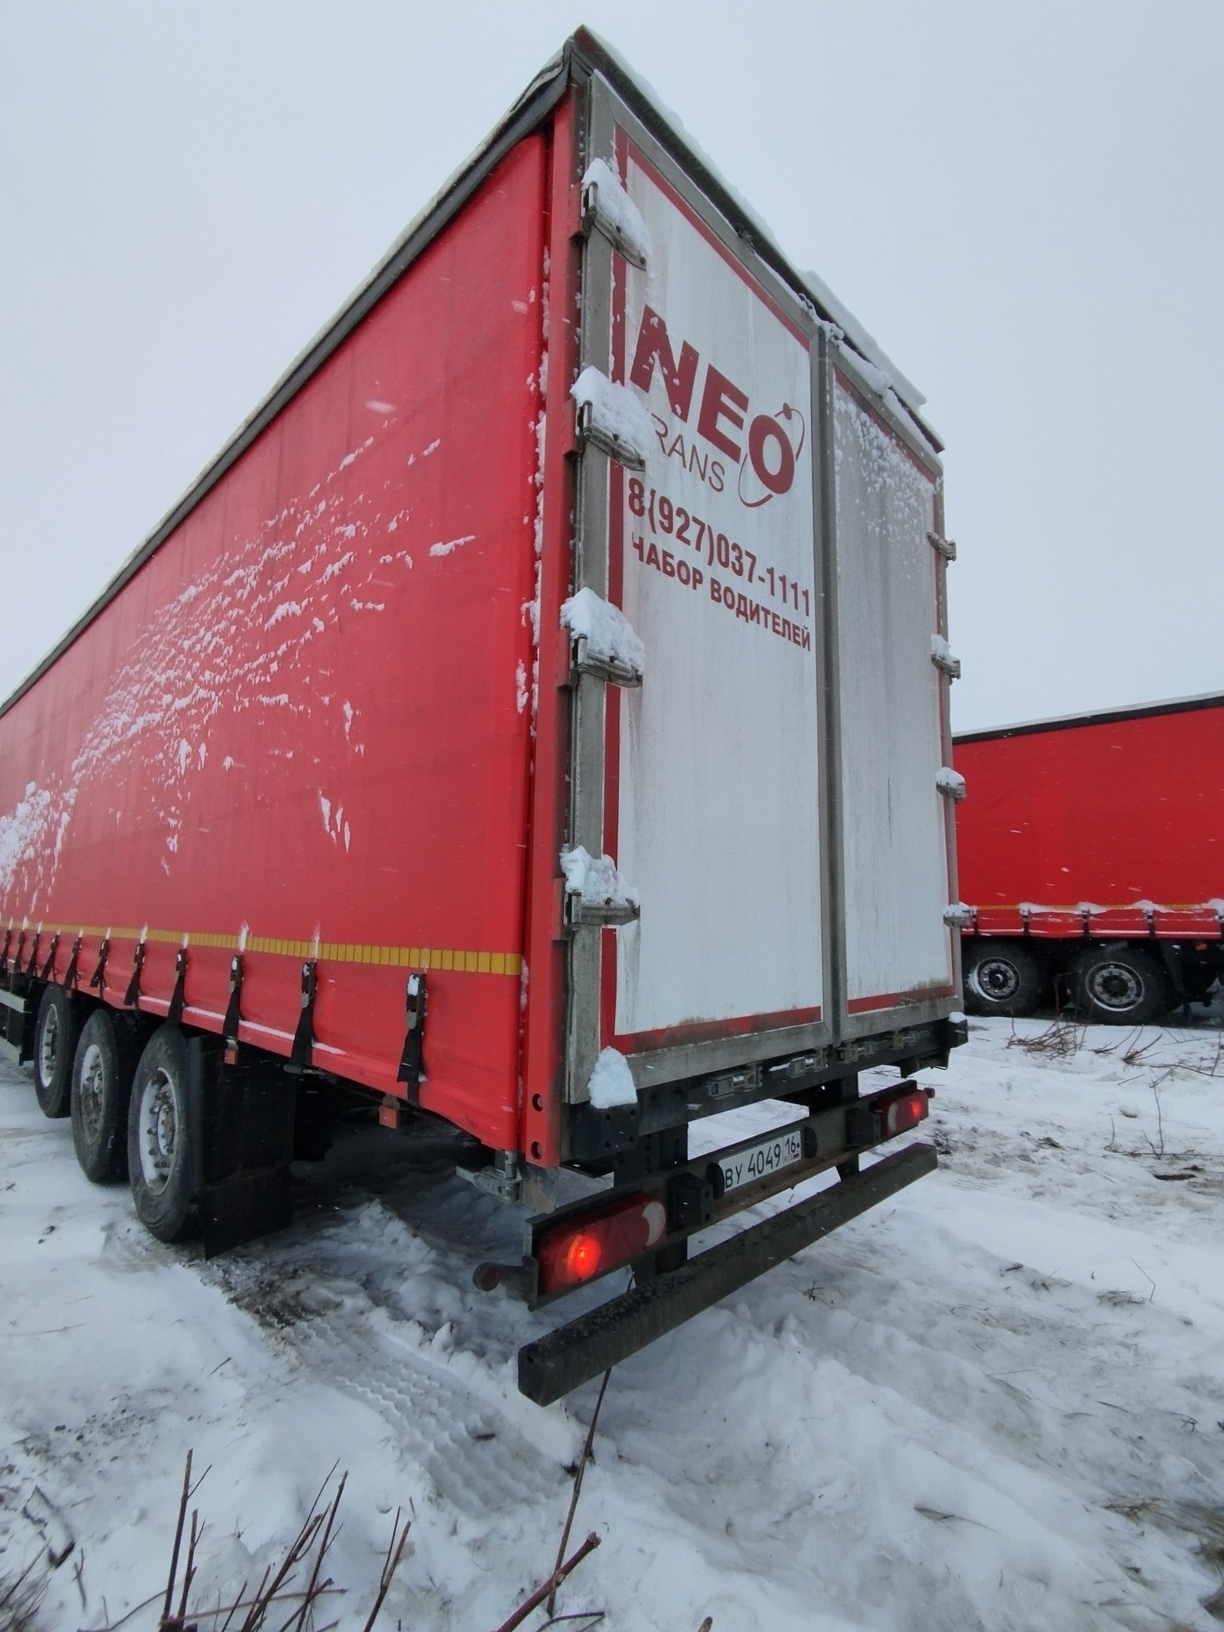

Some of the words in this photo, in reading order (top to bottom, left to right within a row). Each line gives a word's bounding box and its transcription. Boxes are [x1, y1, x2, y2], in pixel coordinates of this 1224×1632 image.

[629, 303, 795, 495] NEO
[649, 411, 726, 493] RANS
[628, 476, 810, 618] 8(927)037-1111
[710, 577, 811, 652] ВОДИТЕЛЕЙ
[747, 1143, 781, 1178] 4049
[784, 1135, 797, 1155] 16
